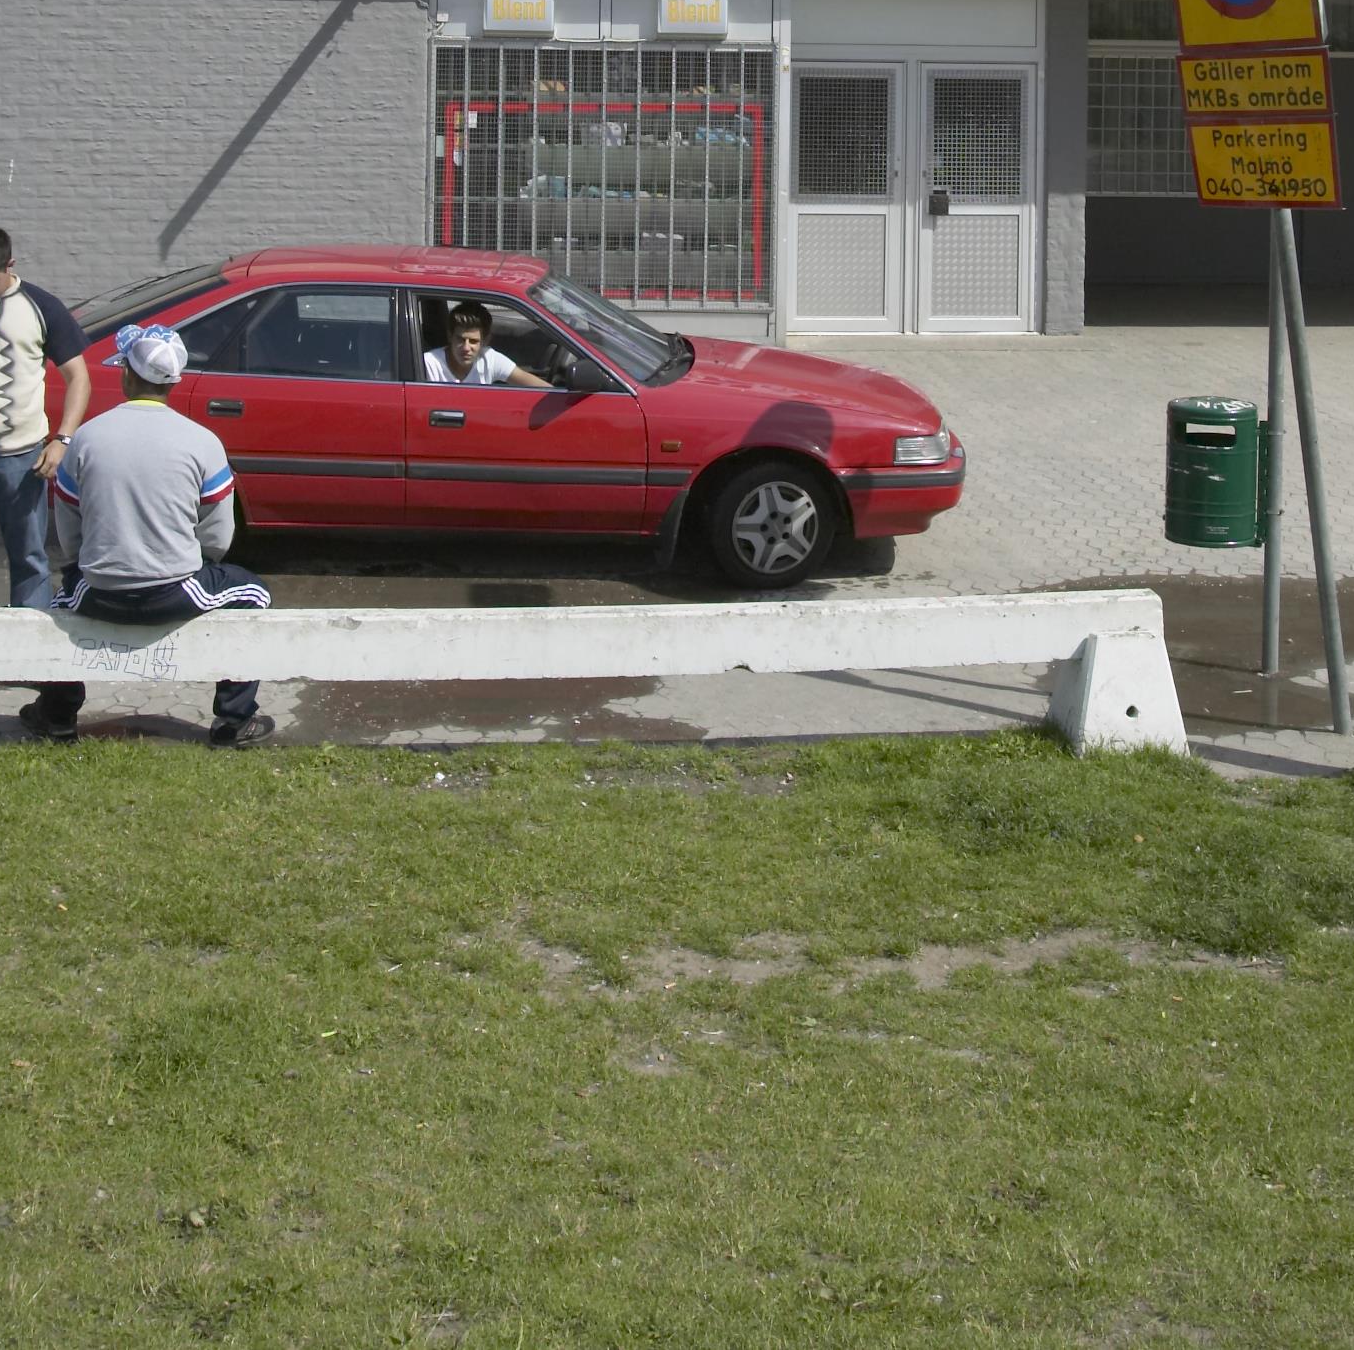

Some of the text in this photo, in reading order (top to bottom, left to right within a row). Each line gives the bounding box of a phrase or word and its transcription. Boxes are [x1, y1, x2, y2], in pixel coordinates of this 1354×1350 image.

[1194, 60, 1312, 81] Gäller inom
[1186, 86, 1324, 107] MKBs område
[1211, 128, 1308, 151] Parkering
[1231, 155, 1294, 176] Malmö
